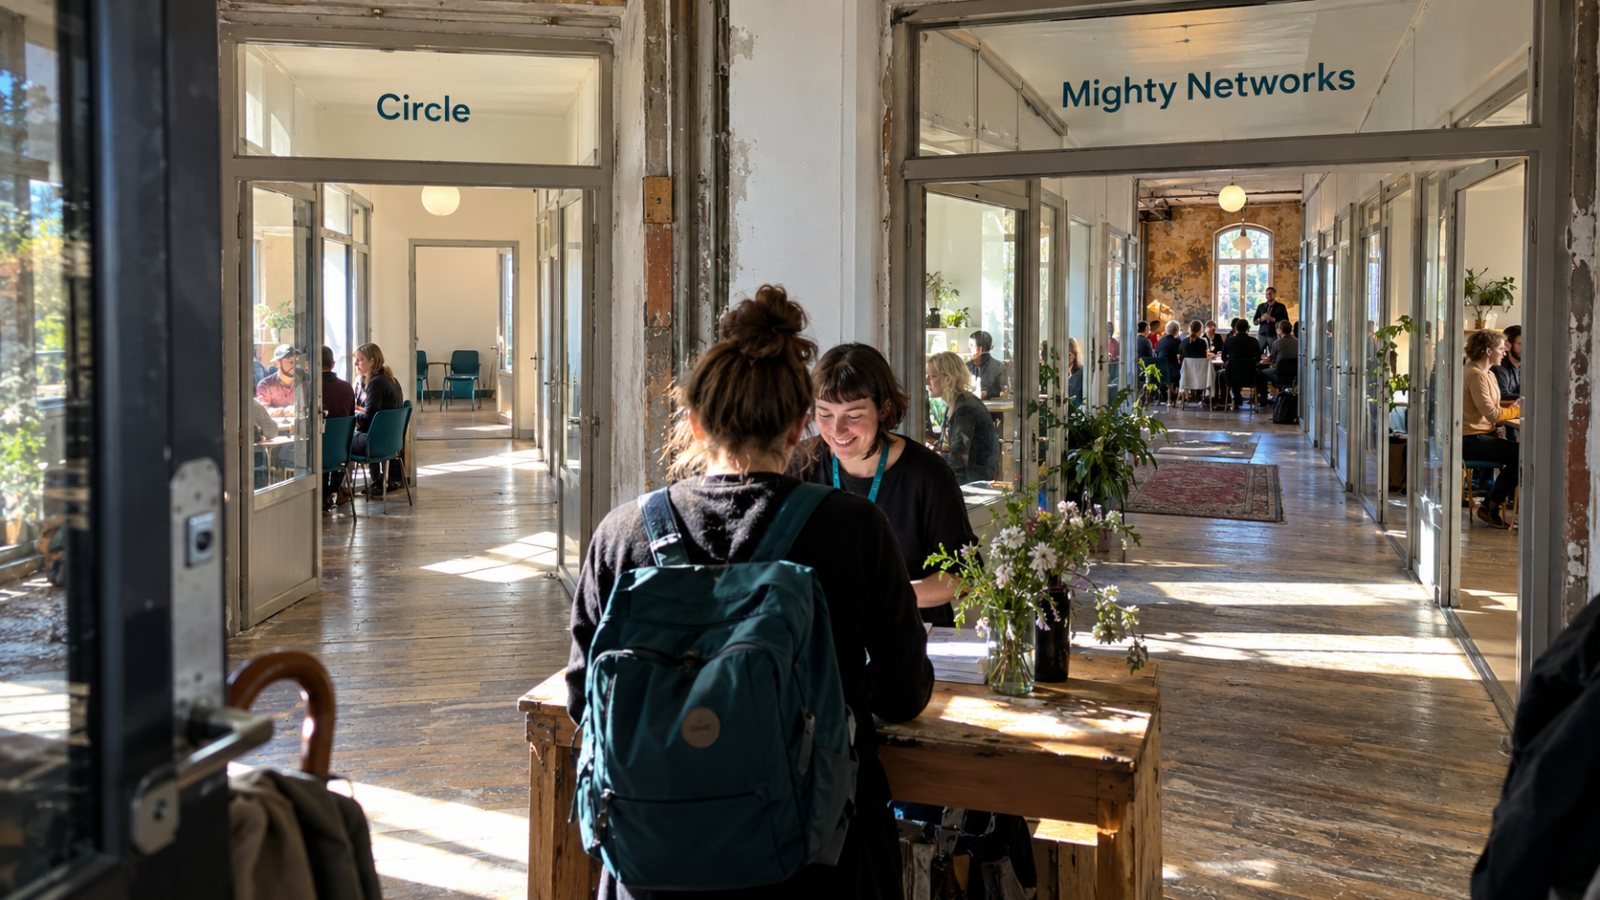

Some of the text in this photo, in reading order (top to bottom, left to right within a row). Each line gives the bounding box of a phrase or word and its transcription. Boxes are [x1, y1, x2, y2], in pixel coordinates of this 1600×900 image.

[1062, 62, 1356, 113] Mighty Networks
[376, 93, 471, 123] Circle
